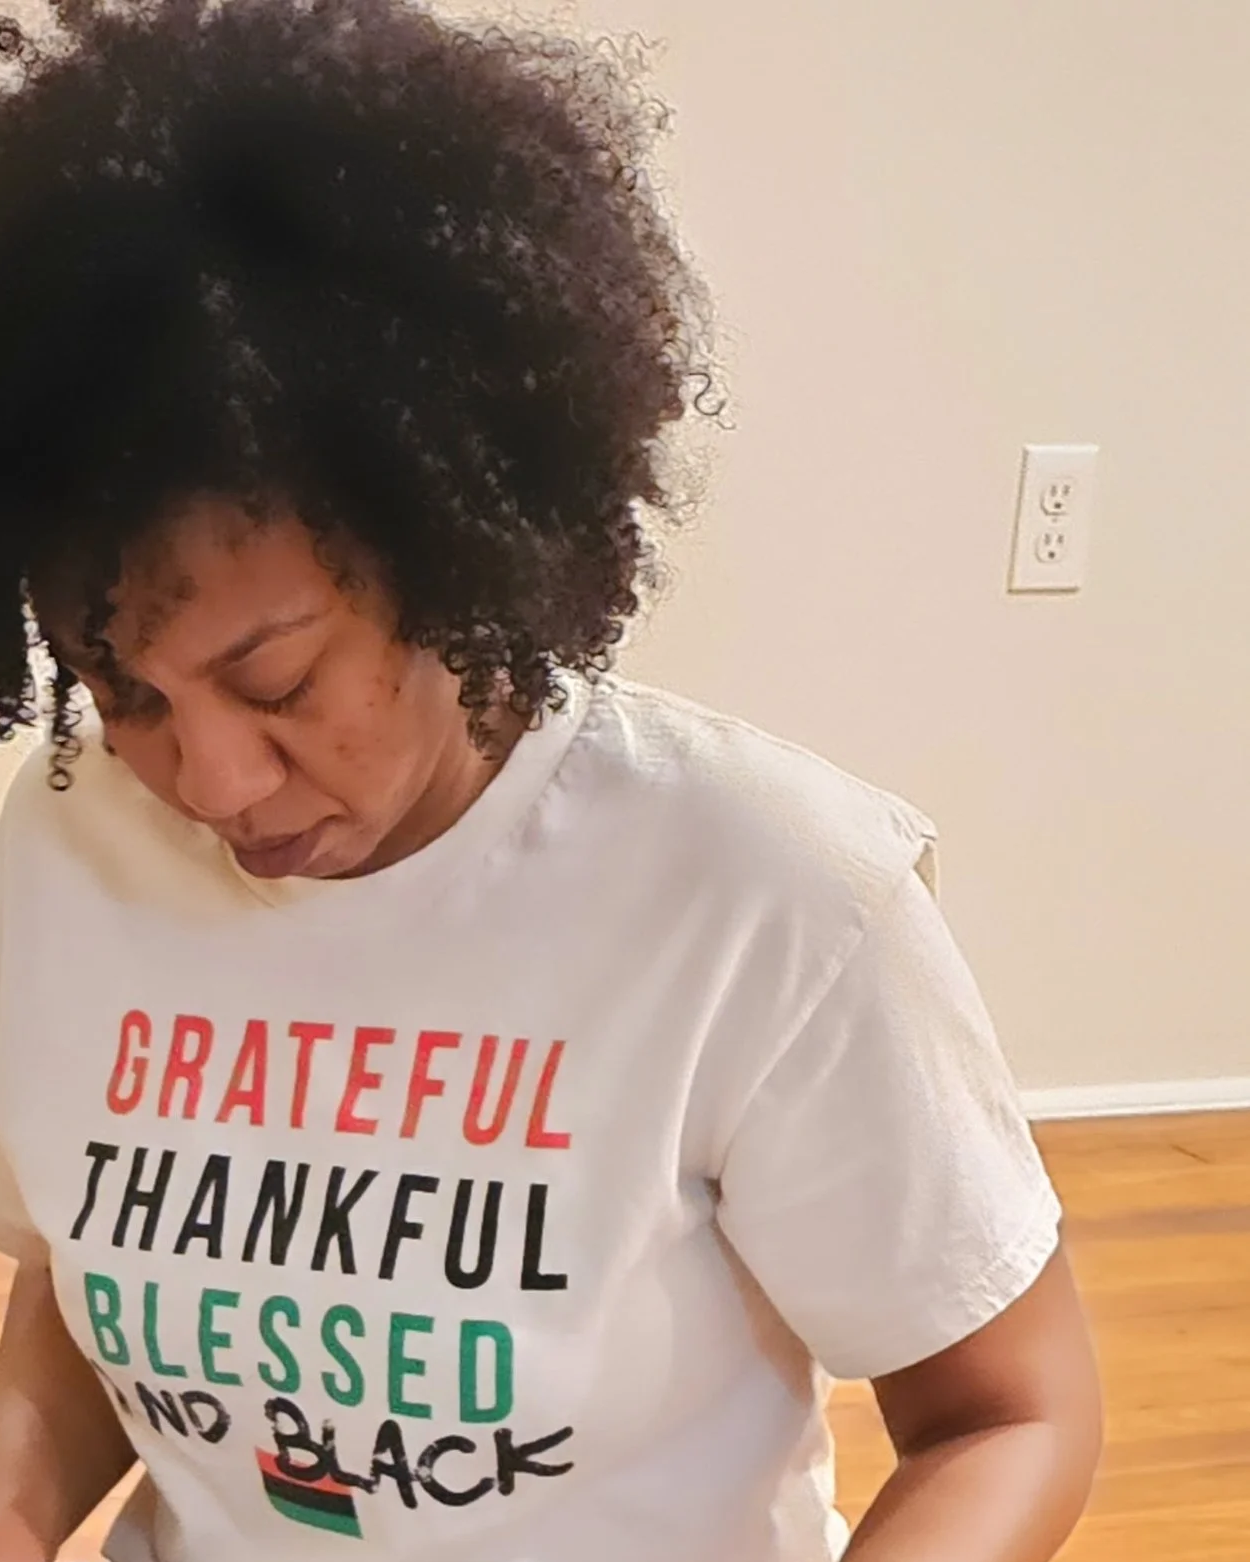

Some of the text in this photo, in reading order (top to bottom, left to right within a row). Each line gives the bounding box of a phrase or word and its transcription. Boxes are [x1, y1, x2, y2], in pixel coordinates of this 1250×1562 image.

[106, 1009, 572, 1149] GRATEFUL
[70, 1141, 568, 1291] THANKFUL
[84, 1272, 514, 1424] BLESSED
[264, 1397, 574, 1508] BLACK
